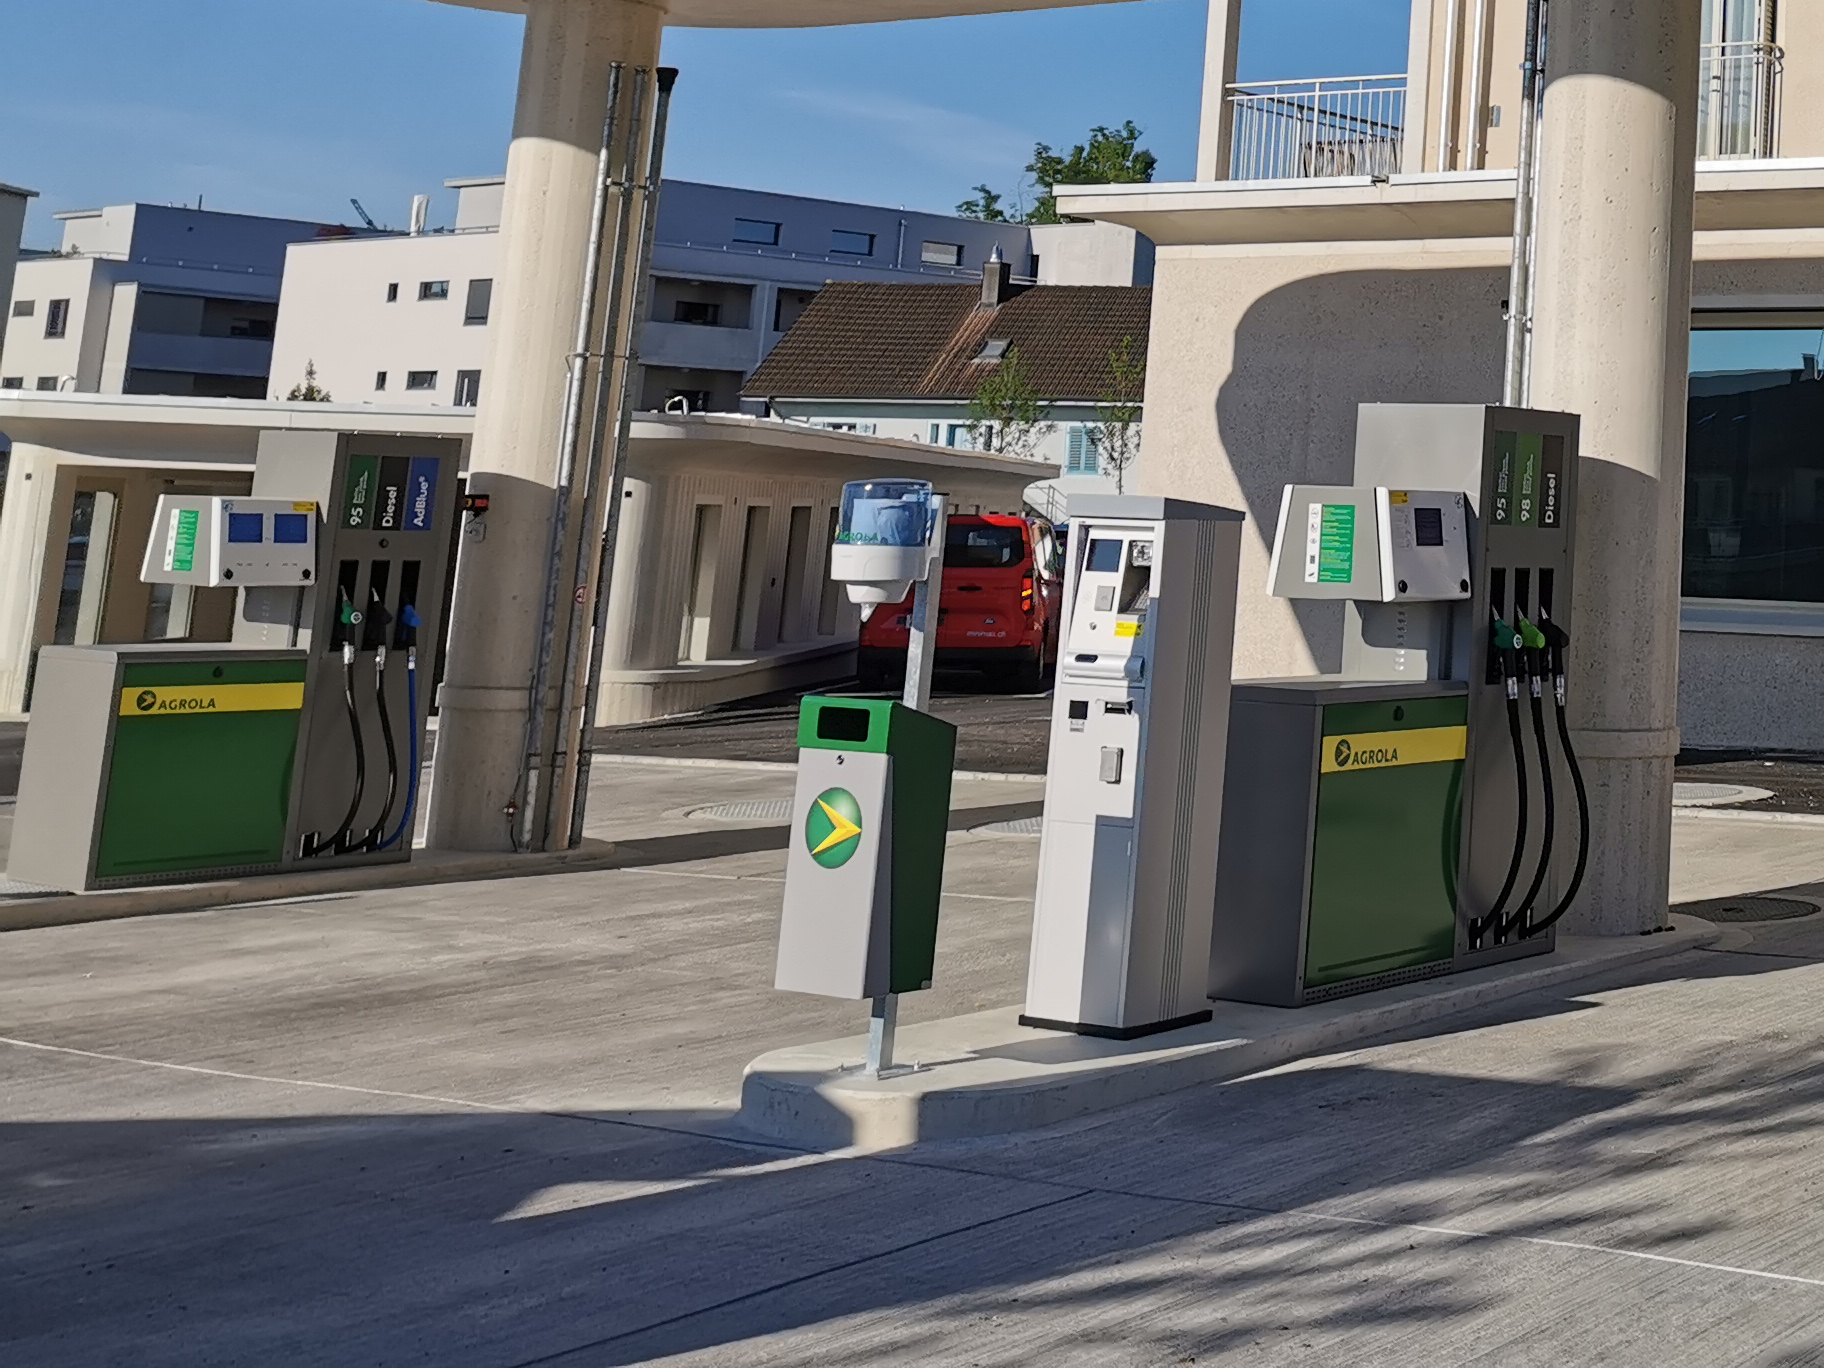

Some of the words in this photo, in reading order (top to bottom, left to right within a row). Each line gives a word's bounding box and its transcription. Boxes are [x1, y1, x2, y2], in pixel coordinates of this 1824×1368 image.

[381, 486, 398, 527] Diesel
[1496, 497, 1507, 521] 95
[1520, 498, 1531, 522] 98
[1544, 473, 1557, 524] Diesel
[349, 506, 363, 526] 95
[157, 697, 217, 711] AGROLA
[1350, 747, 1399, 766] AGROLA
